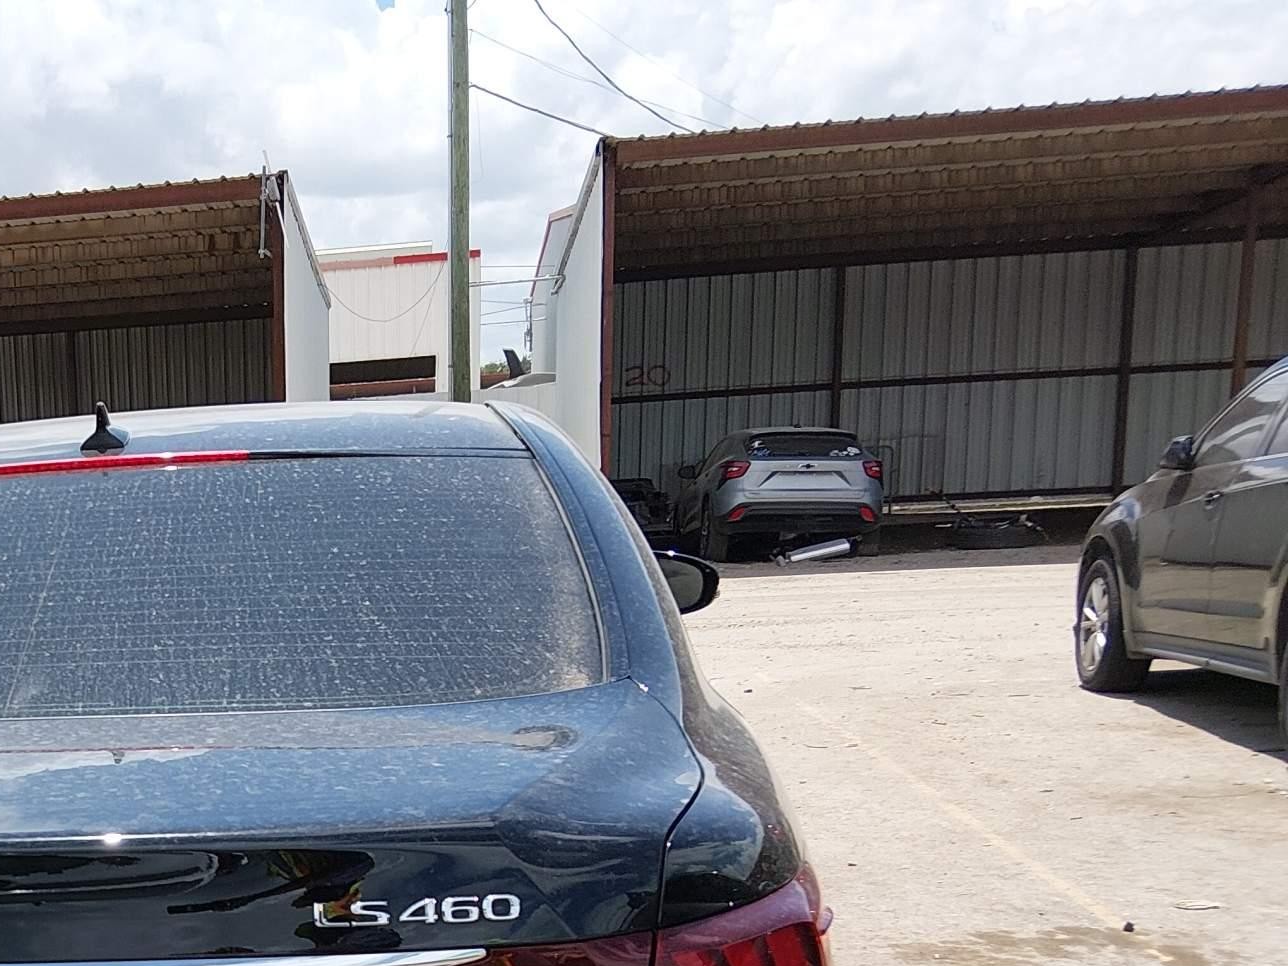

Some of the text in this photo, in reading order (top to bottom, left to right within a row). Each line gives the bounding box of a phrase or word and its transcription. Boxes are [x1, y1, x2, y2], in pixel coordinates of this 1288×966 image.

[624, 364, 671, 388] 20
[313, 894, 521, 928] LS 460
